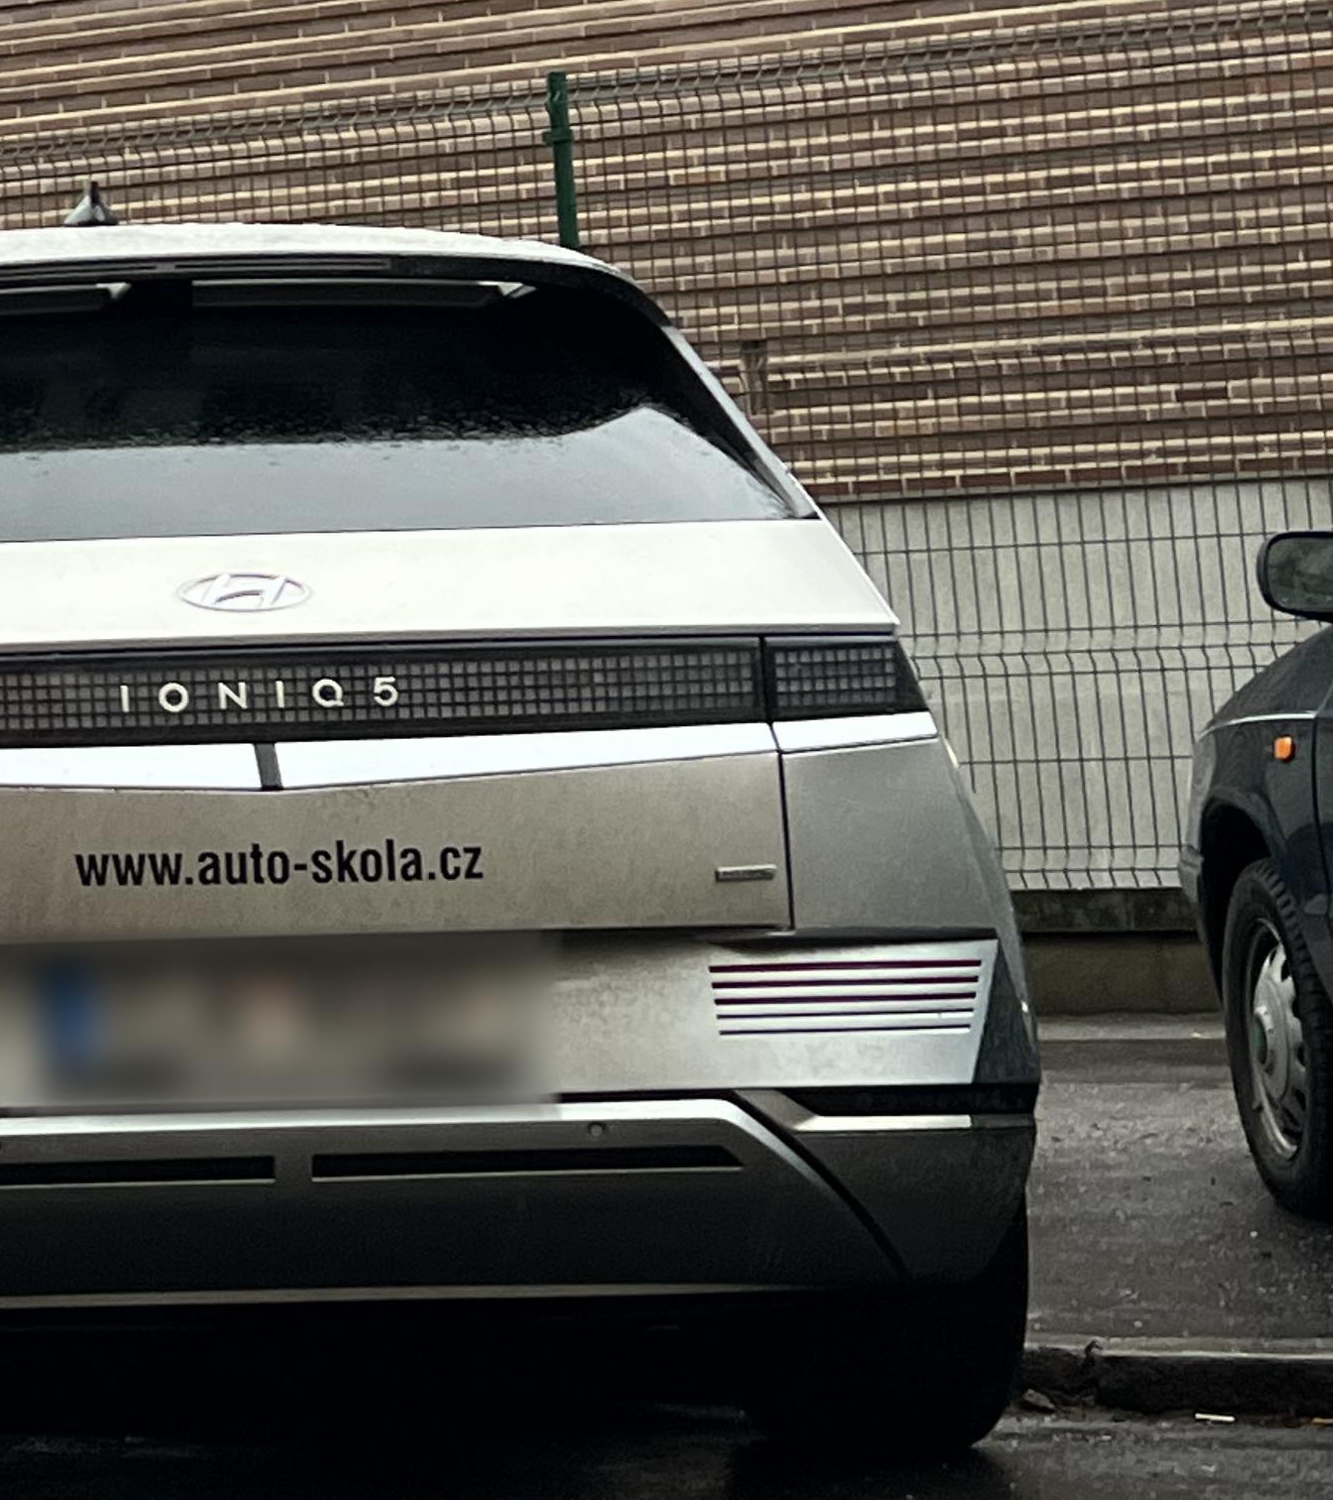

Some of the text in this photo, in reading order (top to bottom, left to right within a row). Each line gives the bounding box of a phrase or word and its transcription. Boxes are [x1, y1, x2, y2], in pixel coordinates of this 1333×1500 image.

[119, 675, 400, 714] IONIQ 5
[75, 838, 485, 887] www.auto-skola.cz
